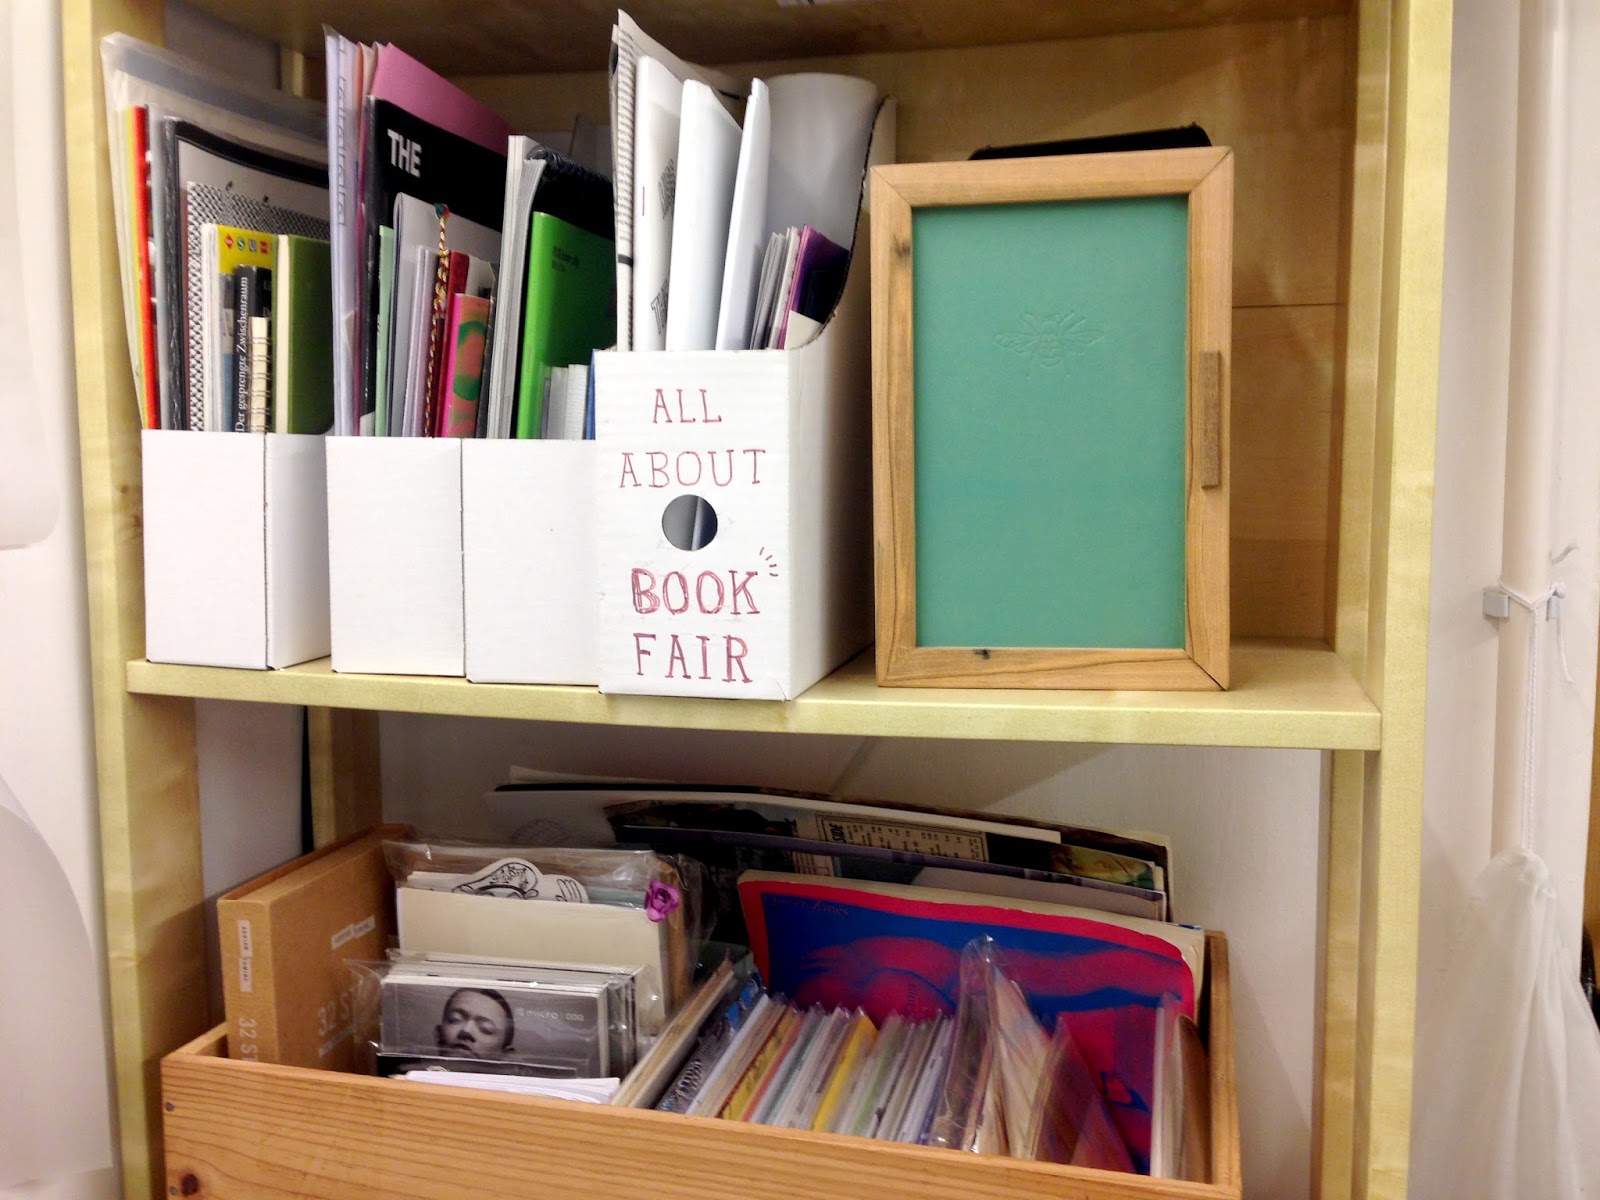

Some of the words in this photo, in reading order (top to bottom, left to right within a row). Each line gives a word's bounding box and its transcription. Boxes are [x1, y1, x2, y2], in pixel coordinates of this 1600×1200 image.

[387, 128, 422, 179] THE
[236, 276, 249, 353] Zwischenraum
[238, 354, 249, 410] gesprengte
[652, 388, 722, 424] ALL
[235, 412, 246, 432] Der
[619, 449, 766, 488] ABOUT
[631, 567, 760, 616] BOOK
[633, 633, 753, 684] FAIR
[239, 1017, 257, 1038] 32
